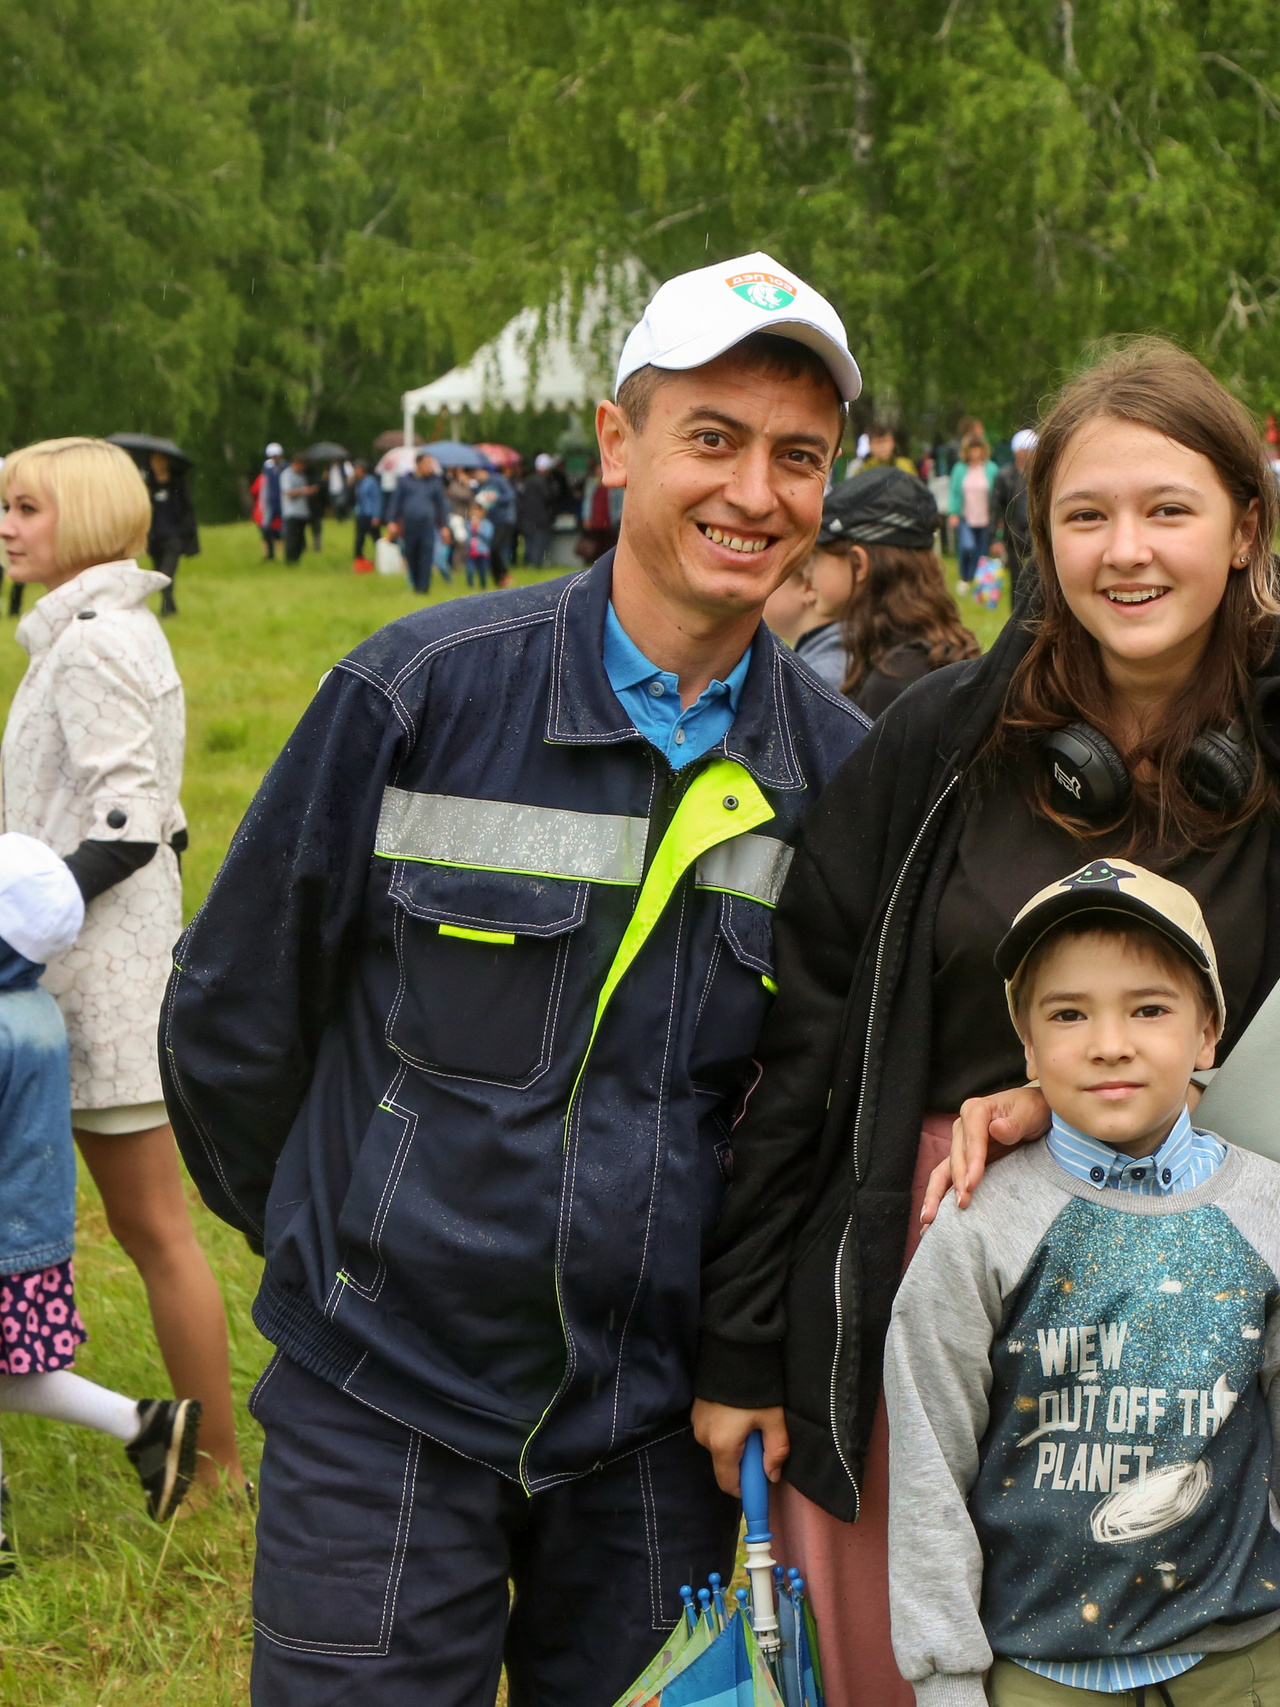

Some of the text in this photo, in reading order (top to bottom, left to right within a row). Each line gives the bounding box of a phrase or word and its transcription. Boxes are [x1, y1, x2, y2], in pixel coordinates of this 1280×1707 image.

[732, 274, 793, 292] ДЭП 103
[1037, 1322, 1128, 1376] WIEW
[1039, 1386, 1100, 1432] OUT
[1106, 1386, 1166, 1433] OFF
[1034, 1442, 1154, 1494] PLANET
